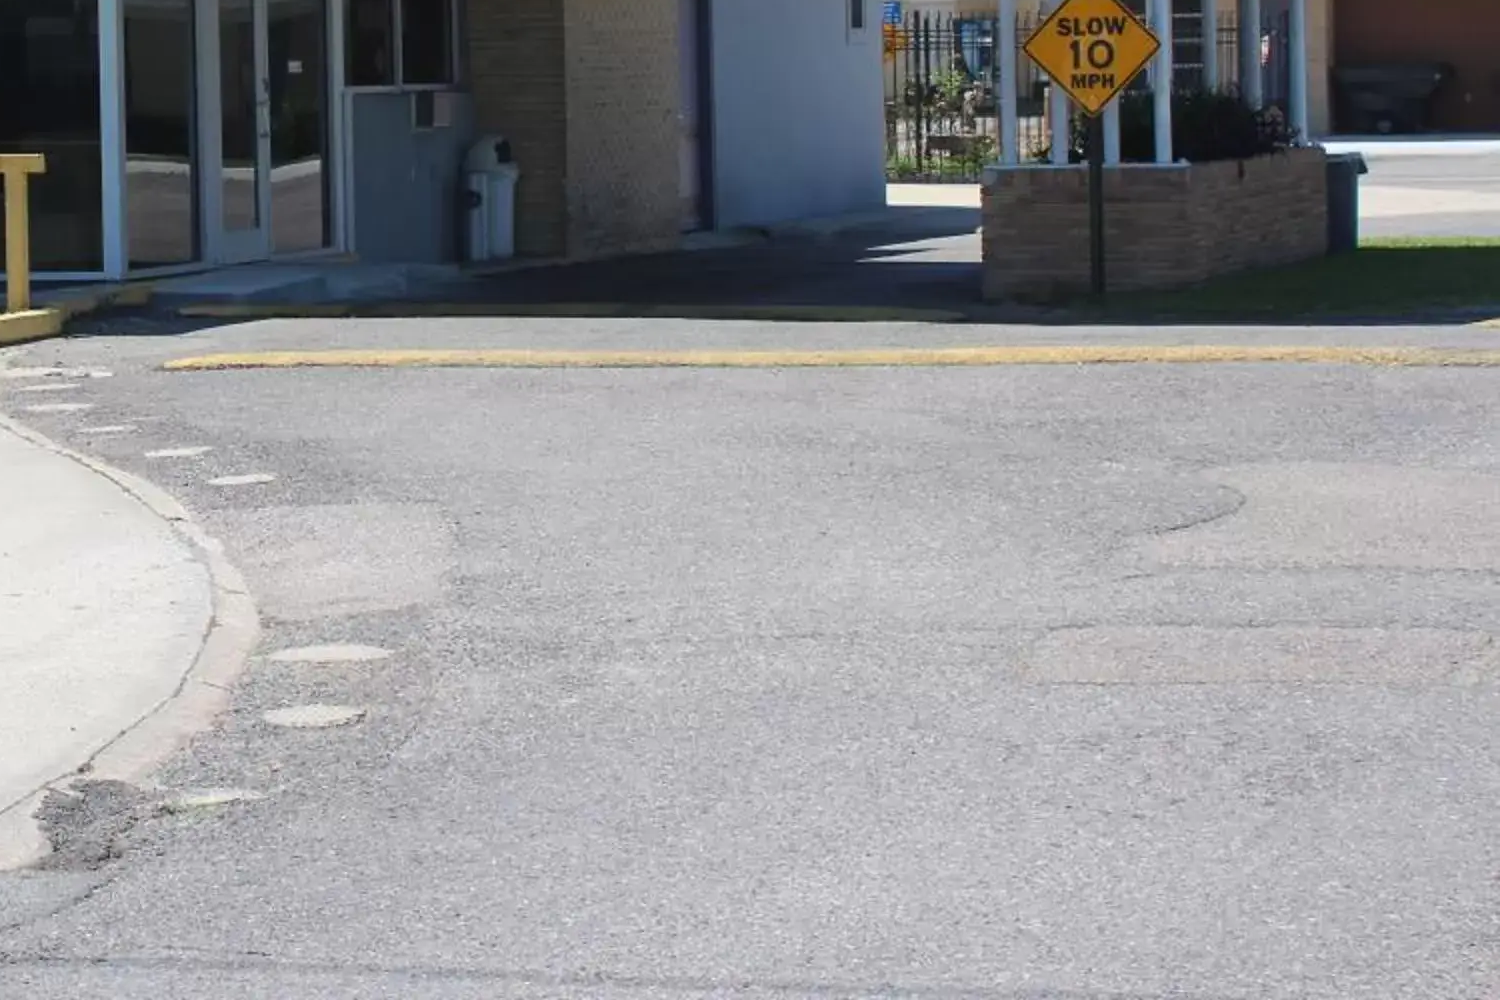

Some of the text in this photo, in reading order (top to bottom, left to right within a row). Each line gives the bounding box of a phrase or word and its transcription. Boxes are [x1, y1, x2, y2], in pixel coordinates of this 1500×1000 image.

[1057, 17, 1126, 36] SLOW
[1069, 40, 1114, 69] 10
[1071, 74, 1115, 89] MPH
